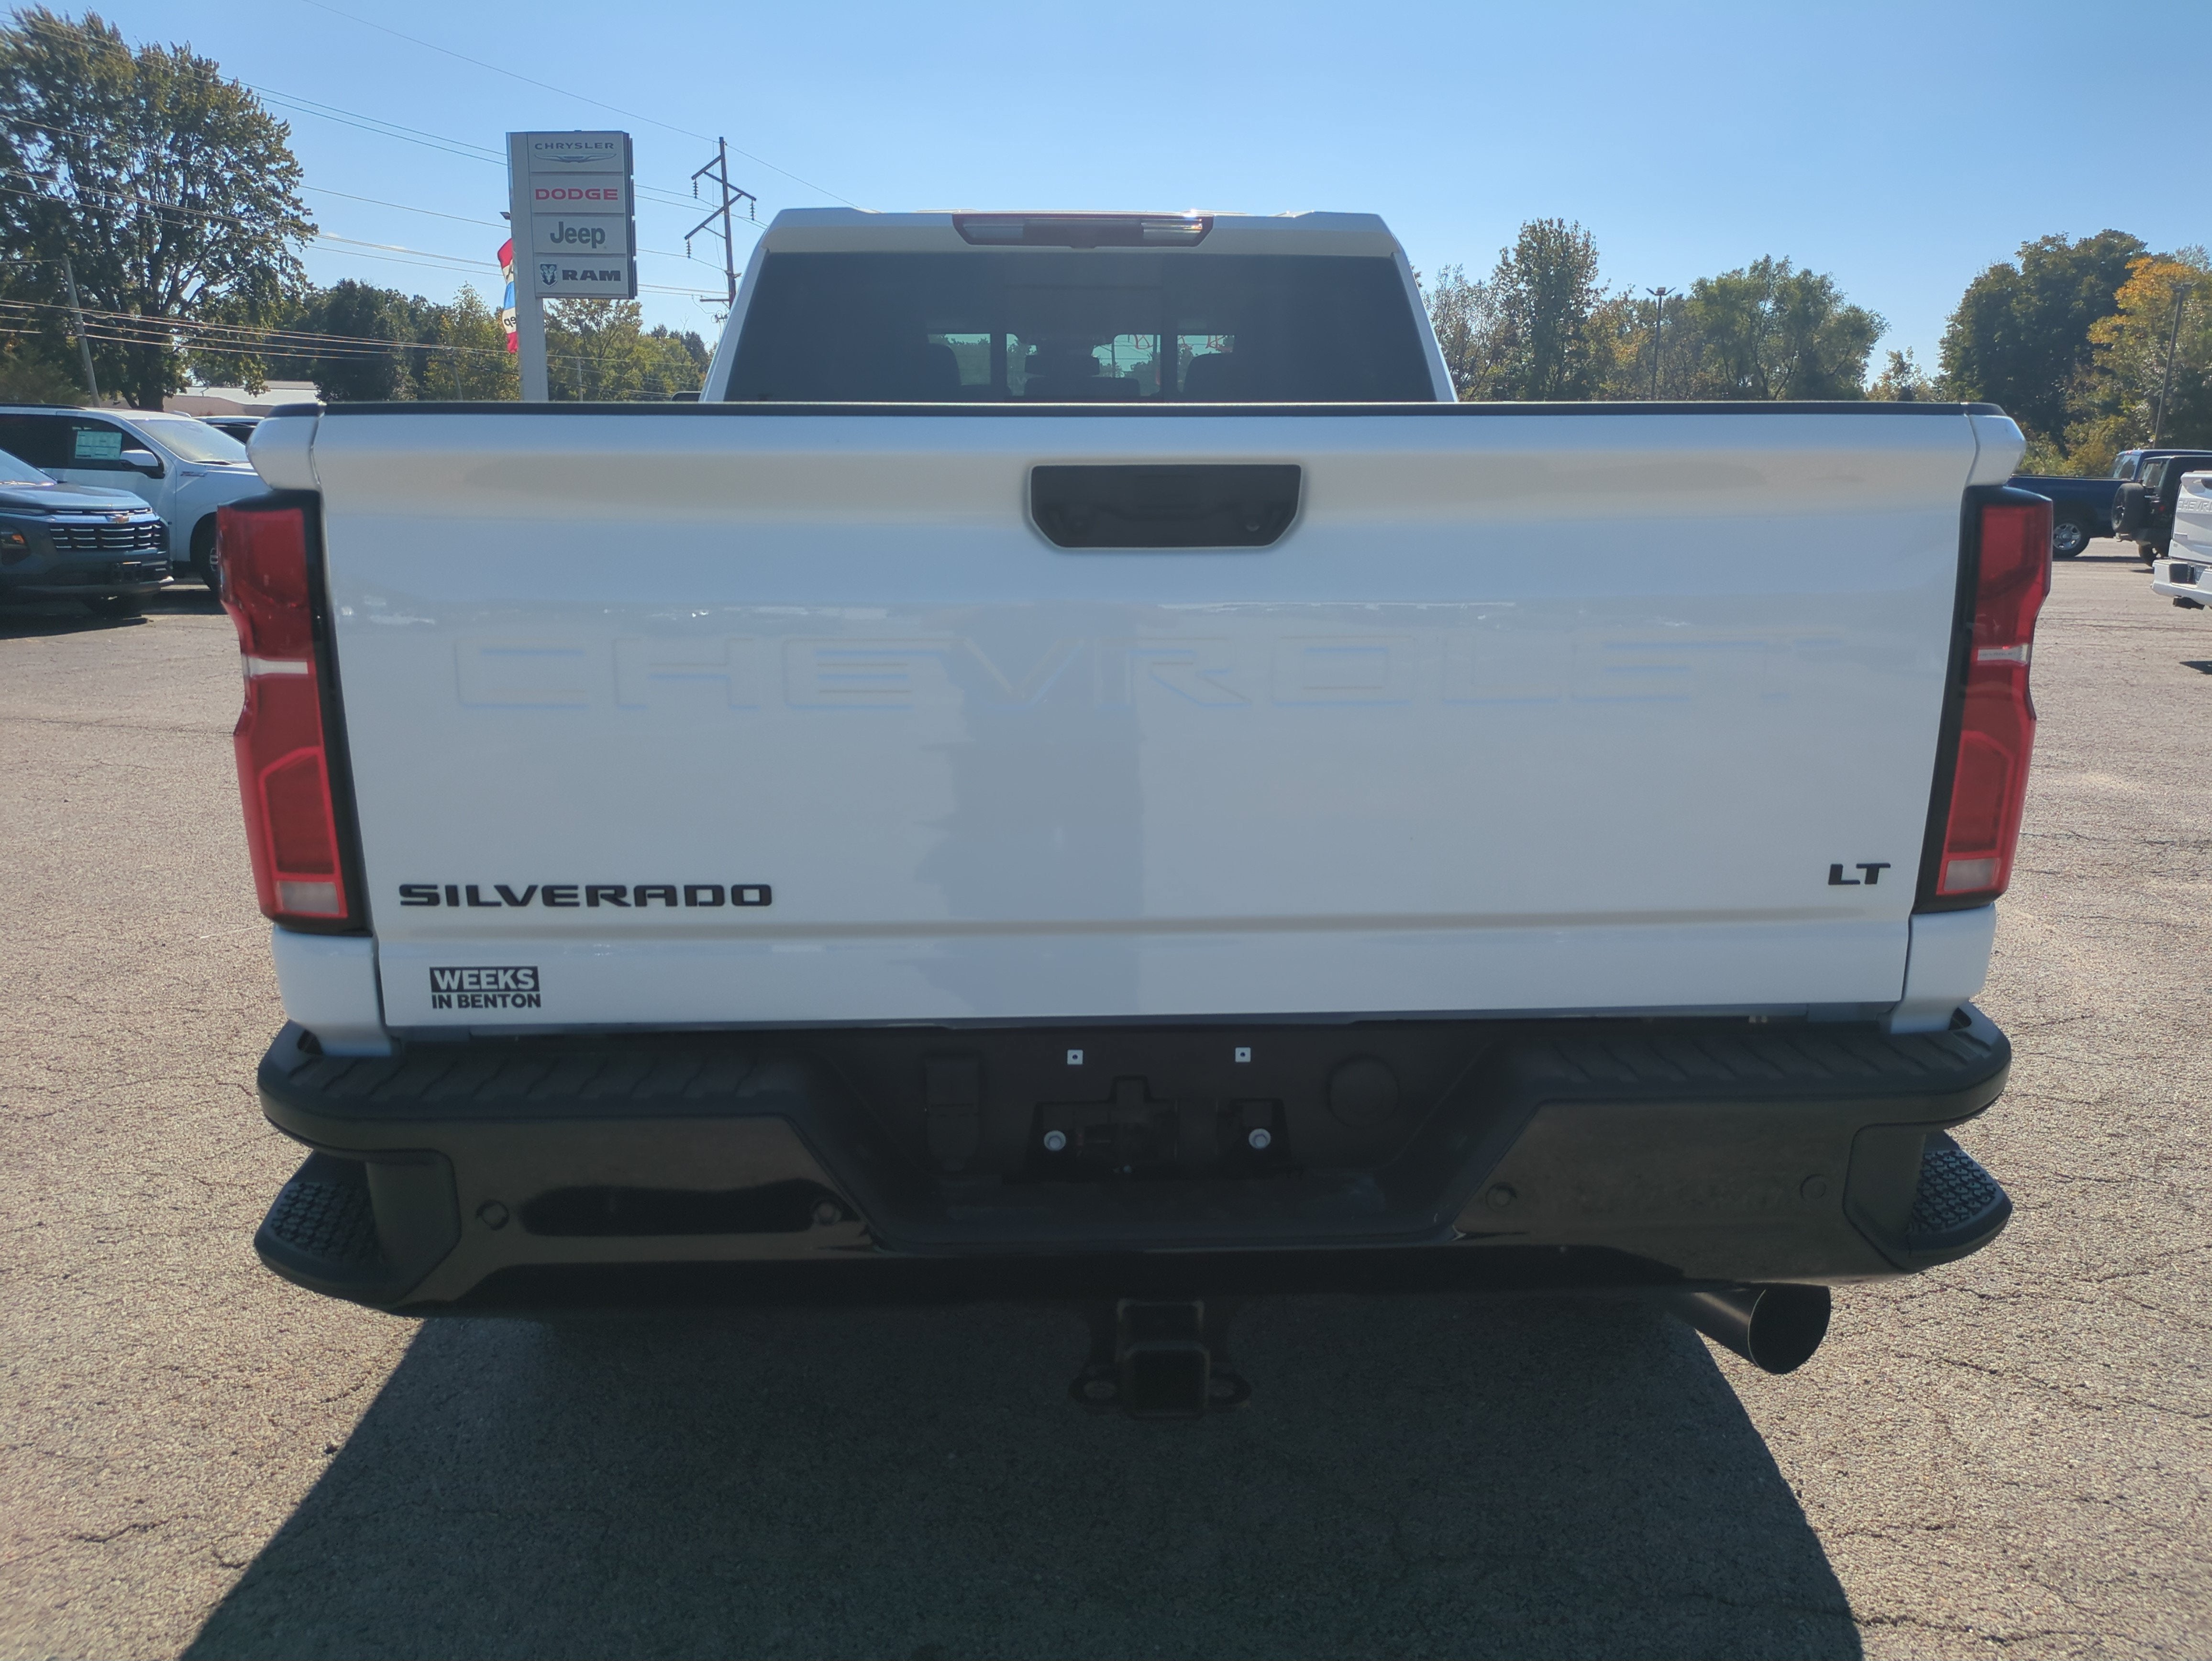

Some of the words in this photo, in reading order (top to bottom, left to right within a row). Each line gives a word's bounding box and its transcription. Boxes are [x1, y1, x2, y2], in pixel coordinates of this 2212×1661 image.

[535, 188, 619, 200] DODGE
[550, 221, 606, 248] Jeep
[562, 269, 621, 281] RAM
[2177, 499, 2212, 513] CHEVR
[454, 632, 1844, 709] CHEVROLET
[1828, 863, 1891, 885] LT
[398, 884, 773, 907] SILVERADO
[433, 968, 535, 990] WEEKS
[431, 994, 453, 1009] IN
[457, 993, 542, 1009] BENTON
